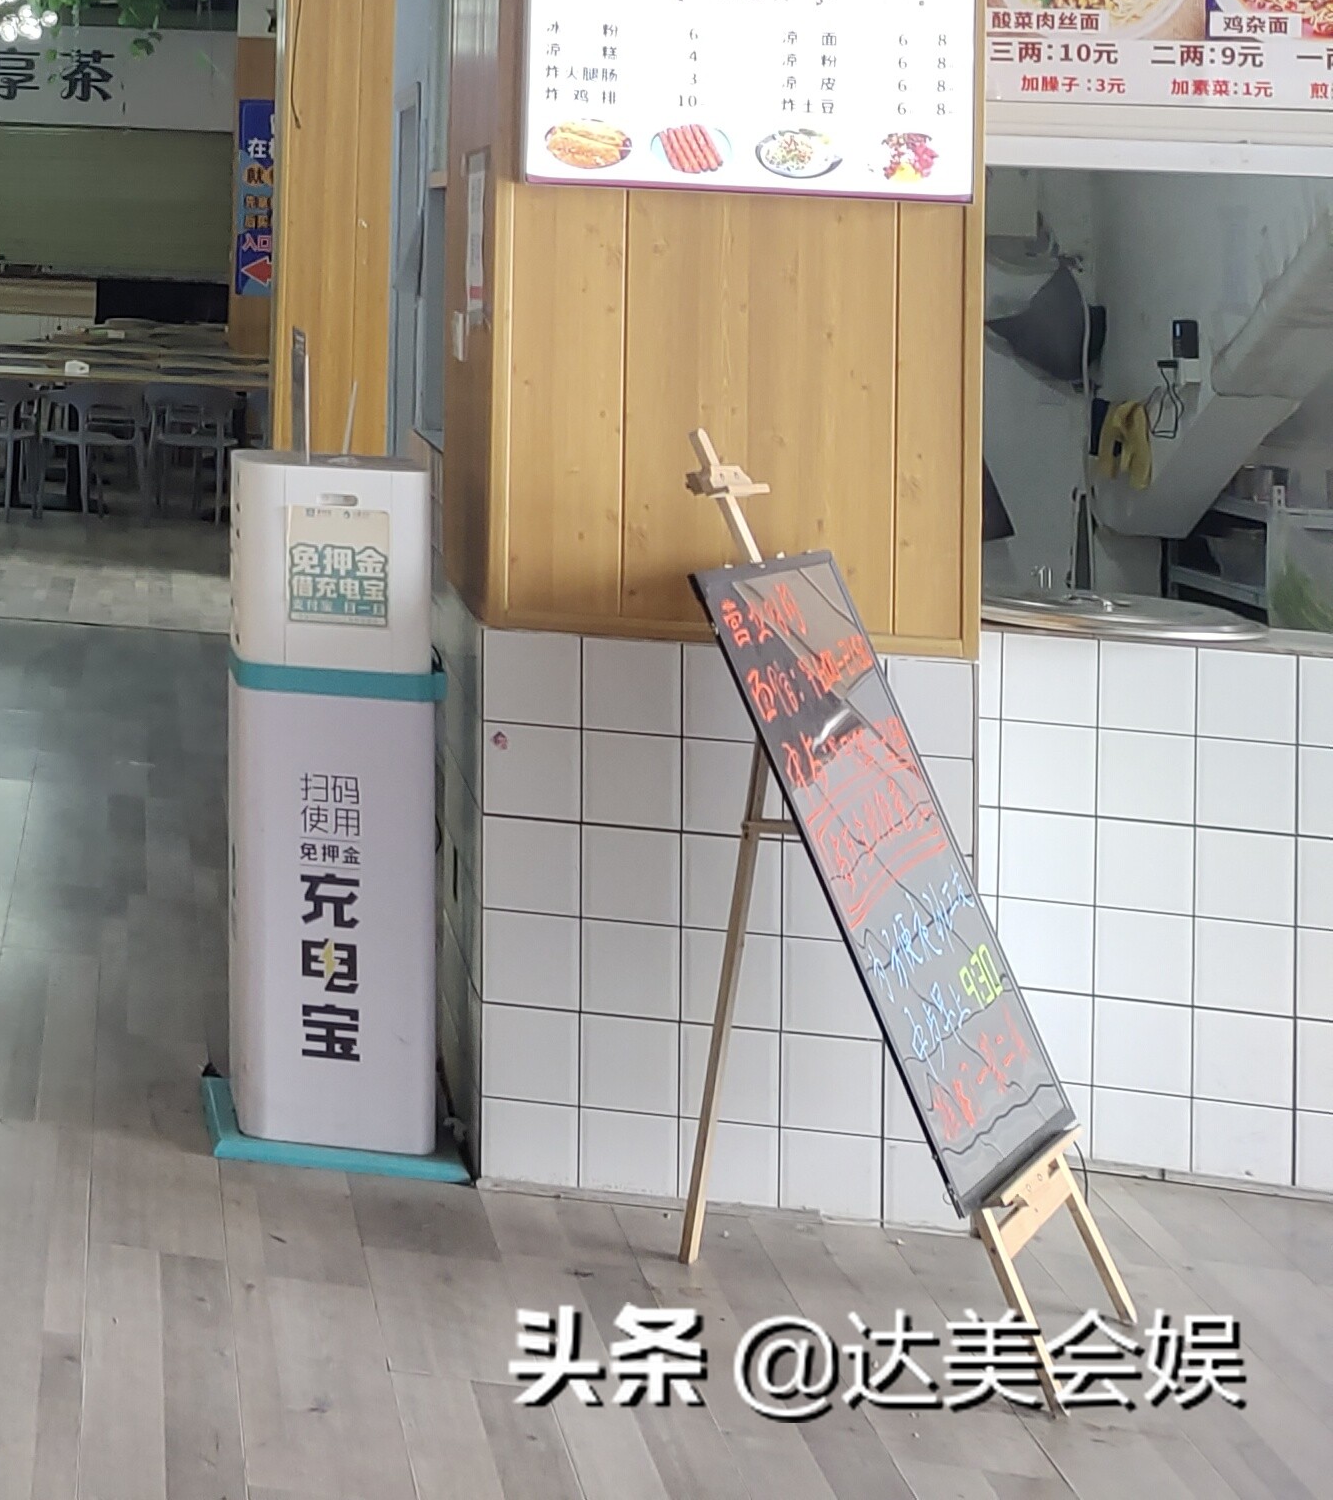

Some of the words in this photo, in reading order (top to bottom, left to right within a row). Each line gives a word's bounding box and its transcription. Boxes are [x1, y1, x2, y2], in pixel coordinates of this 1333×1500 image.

[991, 11, 1100, 31] 酸菜肉丝面
[1223, 16, 1288, 35] 鸡杂面
[899, 35, 907, 46] 6
[938, 35, 946, 46] 8
[898, 57, 907, 69] 6
[937, 57, 946, 69] 8
[1296, 47, 1333, 70] 一
[898, 80, 907, 91] 6
[937, 80, 945, 92] 8
[679, 95, 697, 107] 10
[898, 103, 906, 115] 6
[937, 103, 945, 115] 8
[242, 233, 272, 252] 入口
[292, 545, 385, 577] 免押金
[293, 576, 385, 600] 借充电宝
[300, 773, 359, 804] 扫码
[301, 805, 360, 837] 使用
[300, 843, 361, 865] 免押金
[300, 871, 361, 1063] 充电宝
